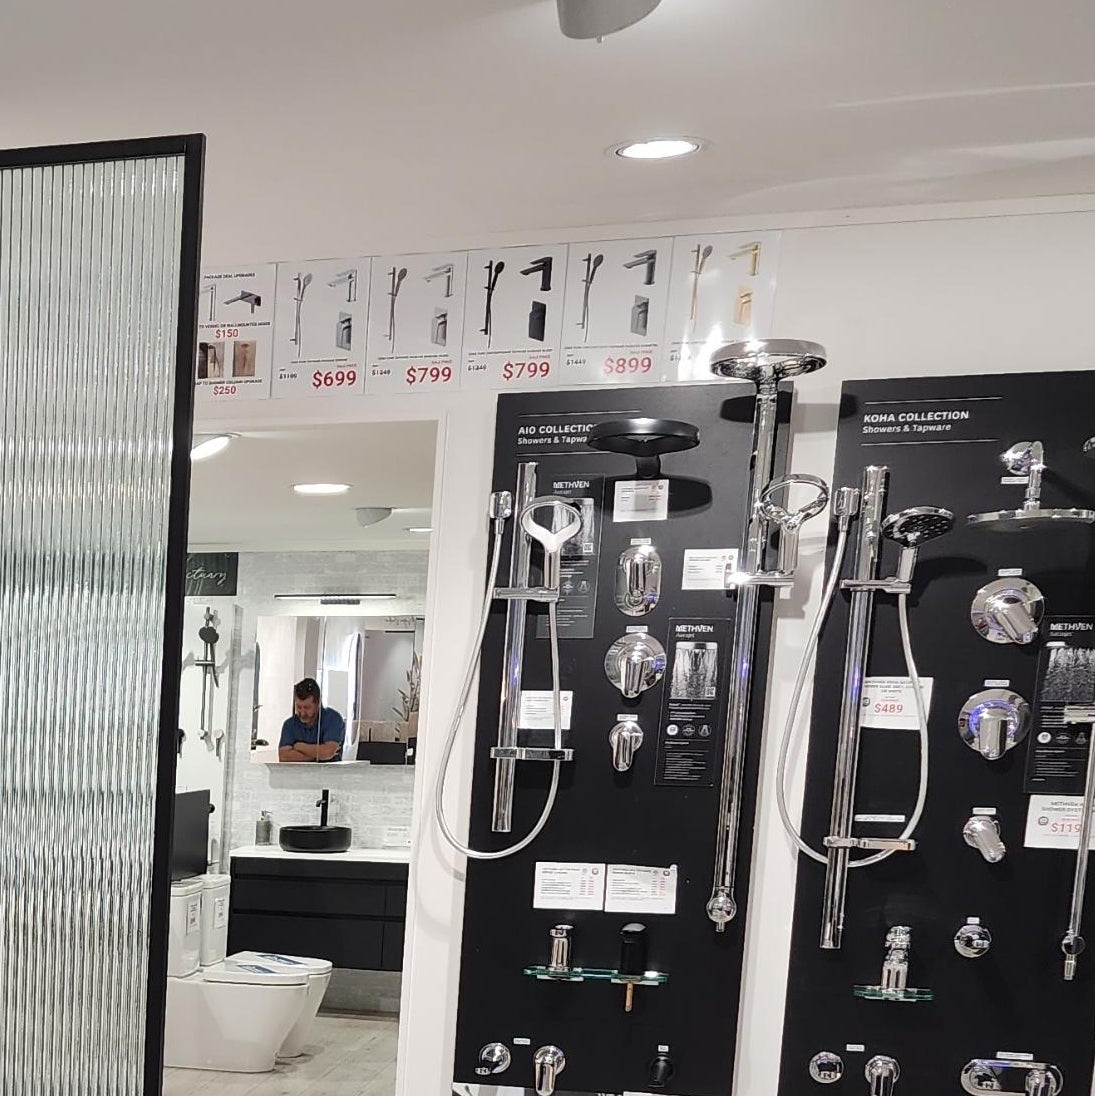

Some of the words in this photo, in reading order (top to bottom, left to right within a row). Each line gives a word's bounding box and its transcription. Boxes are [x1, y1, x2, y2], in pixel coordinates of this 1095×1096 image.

[215, 329, 239, 339] $150
[502, 361, 550, 381] $799
[604, 356, 652, 376] $899
[312, 369, 357, 389] $699
[406, 366, 452, 386] $799
[213, 385, 237, 395] $250
[863, 413, 896, 423] KOHA
[898, 410, 969, 422] COLLECTION
[518, 426, 536, 435] AIO
[539, 423, 594, 434] COLLECTIO
[862, 425, 901, 434] Showers
[903, 424, 910, 432] &
[912, 424, 952, 434] Tapware
[517, 437, 552, 445] Showers
[553, 436, 560, 444] &
[561, 435, 587, 445] Tapwa
[186, 566, 227, 587] ctuary
[1050, 622, 1094, 631] METHVEN
[874, 703, 904, 713] $489
[1051, 822, 1083, 833] $119
